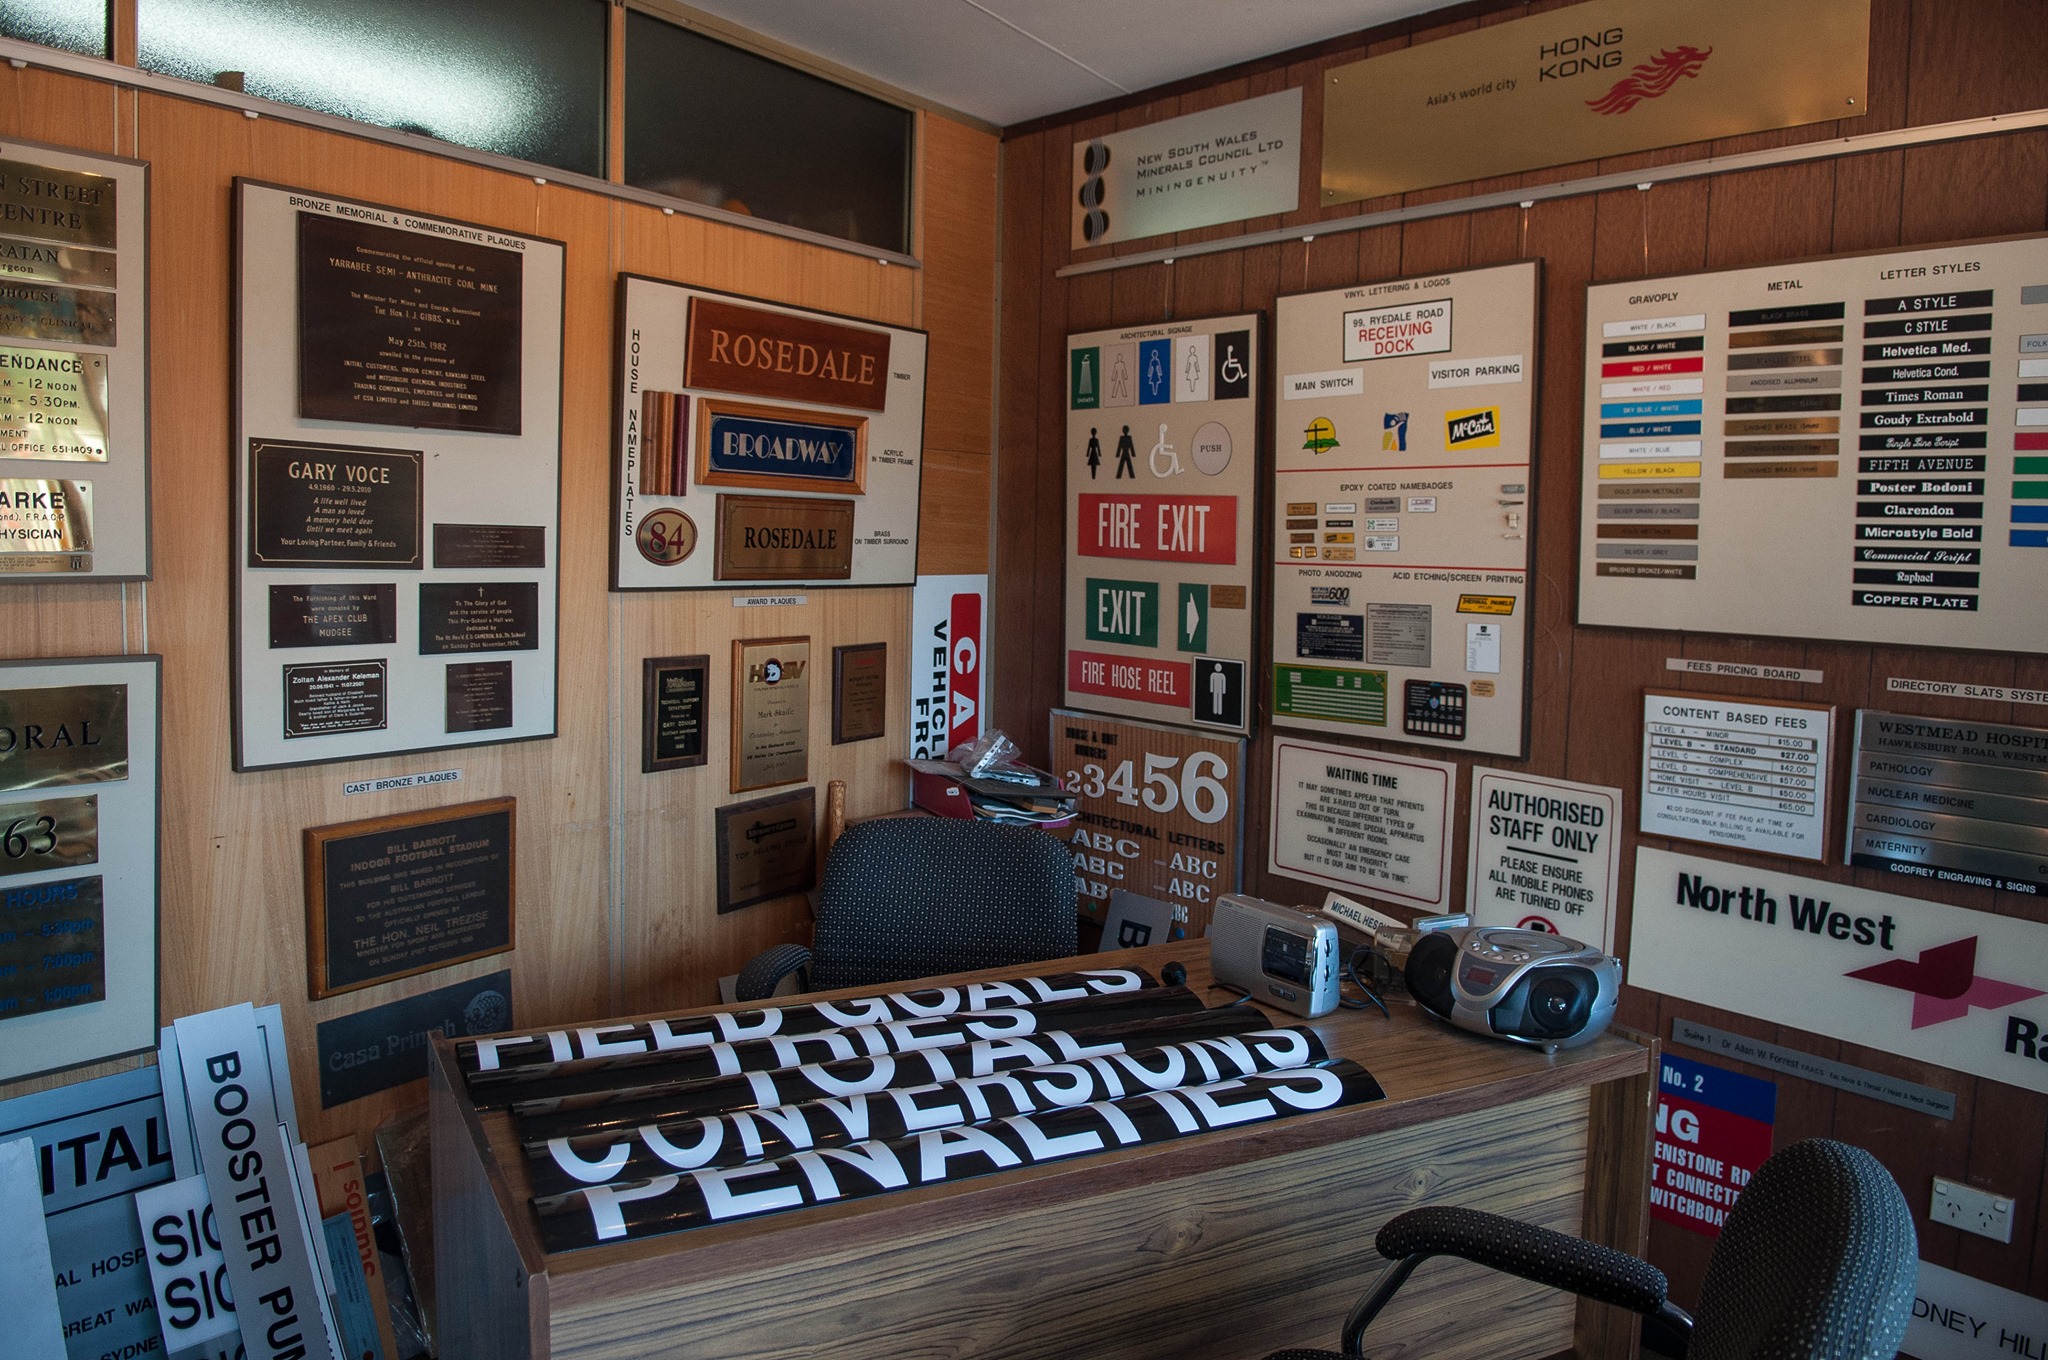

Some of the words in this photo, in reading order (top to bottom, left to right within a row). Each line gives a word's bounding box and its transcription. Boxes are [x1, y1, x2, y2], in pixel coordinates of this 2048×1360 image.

[1541, 27, 1623, 60] HONG
[1540, 50, 1622, 82] KONG
[1426, 90, 1456, 106] Asia's
[1460, 84, 1493, 99] world
[1497, 78, 1517, 92] city
[1138, 154, 1162, 165] NEW
[1168, 143, 1209, 158] SOUTH
[1215, 132, 1257, 148] WALES
[1137, 161, 1192, 179] MINERALS
[1199, 148, 1252, 166] COUNCIL
[290, 196, 331, 212] BRONZE
[336, 204, 387, 223] MEMORIAL
[393, 216, 399, 224] &
[405, 219, 482, 242] COMMEMORATIVE
[487, 234, 526, 250] PLAQUES
[330, 258, 371, 272] YARRABEE
[1880, 267, 1926, 280] LETTER
[1933, 262, 1980, 275] STYLES
[1369, 283, 1410, 296] LETTERING
[1424, 278, 1450, 288] LOGOS
[1768, 280, 1802, 291] METAL
[1629, 292, 1678, 305] GRAVOPLY
[1898, 300, 1907, 311] A
[1914, 296, 1956, 310] STYLE
[1370, 312, 1411, 325] RYEDALE
[1417, 308, 1443, 318] ROAD
[1905, 323, 1912, 333] C
[1916, 320, 1948, 332] STYLE
[1120, 329, 1164, 339] ARCHITECTURAL
[1168, 326, 1192, 334] SIGNAGE
[1359, 322, 1432, 342] RECEIVING
[709, 329, 875, 385] ROSEDALE
[1375, 338, 1414, 355] DOCK
[1882, 344, 1936, 357] Helvetica
[1942, 342, 1971, 354] Med.
[631, 329, 640, 393] HOUSE
[1432, 368, 1470, 379] VISITOR
[1475, 364, 1520, 376] PARKING
[894, 372, 910, 381] TIMBER
[1893, 368, 1932, 379] Helvetica
[1936, 367, 1959, 377] Cond.
[1295, 382, 1316, 391] MAIN
[1321, 378, 1353, 389] SWITCH
[1886, 391, 1918, 402] Times
[1924, 390, 1963, 401] Roman
[1452, 413, 1495, 440] McCain
[1875, 414, 1912, 426] Goudy
[1916, 412, 1974, 424] Extrabold
[723, 432, 843, 464] BROADWAY
[1200, 444, 1222, 452] PUSH
[288, 462, 336, 481] GARY
[346, 465, 390, 484] VOCE
[625, 409, 638, 536] NAMEPLATES
[1870, 459, 1909, 470] FIFTH
[1918, 459, 1973, 469] AVENUE
[1340, 483, 1363, 491] EPOXY
[1400, 482, 1453, 490] NAMEBADGES
[1870, 482, 1915, 493] Poster
[1922, 482, 1972, 493] Bodoni
[1884, 505, 1954, 515] Clarendon
[650, 521, 684, 555] 84
[744, 527, 837, 550] ROSEDALE
[1098, 503, 1141, 548] FIRE
[1158, 504, 1209, 553] EXIT
[1865, 528, 1938, 538] Microstyle
[1942, 528, 1973, 538] Bold
[1863, 549, 1930, 561] Commercial
[1934, 551, 1971, 563] Script
[1486, 575, 1523, 584] PRINTING
[1897, 572, 1933, 583] Raphael
[770, 597, 796, 605] PLAQUES
[1329, 587, 1349, 599] 600
[1863, 594, 1918, 605] COPPER
[1922, 596, 1968, 608] PLATE
[1098, 589, 1146, 636] EXIT
[319, 628, 352, 637] MUDGEE
[1082, 661, 1105, 685] FIRE
[1112, 664, 1142, 691] HOSE
[1148, 668, 1176, 695] REEL
[1687, 662, 1711, 672] FEES
[1718, 664, 1757, 676] PRICING
[1764, 668, 1800, 679] BOARD
[1891, 680, 1956, 694] DIRECTORY
[1965, 686, 2003, 698] SLATS
[1664, 706, 1719, 721] CONTENT
[1727, 711, 1767, 726] BASED
[1776, 716, 1807, 729] FEES
[1880, 721, 1977, 742] WESTMEAD
[1781, 752, 1809, 761] $27.00
[1878, 738, 1958, 753] HAWKESBURY
[1963, 746, 1997, 759] ROAD,
[1326, 766, 1368, 784] WAITING
[1372, 774, 1397, 789] TIME
[1870, 762, 1933, 777] PATHOLOGY
[346, 784, 370, 794] CAST
[376, 778, 412, 790] BRONZE
[417, 771, 457, 784] PLAQUES
[1489, 789, 1604, 827] AUTHORISED
[1868, 788, 1918, 802] NUCLEAR
[1923, 794, 1974, 810] MEDICINE
[1866, 814, 1936, 831] CARDIOLOGY
[4, 815, 57, 859] 63
[1072, 828, 1140, 858] ABC
[1169, 831, 1224, 855] LETTERS
[1490, 815, 1543, 842] STAFF
[1553, 827, 1598, 853] ONLY
[1866, 839, 1926, 856] MATERNITY
[1169, 852, 1216, 879] ABC
[1501, 857, 1537, 875] PLEASE
[1542, 865, 1582, 883] ENSURE
[1489, 869, 1507, 883] ALL
[1512, 873, 1547, 892] MOBILE
[1552, 883, 1593, 902] PHONES
[1890, 864, 1934, 879] GODFREY
[1938, 871, 1992, 888] ENGRAVING
[1996, 880, 2002, 888] &
[2006, 881, 2036, 893] SIGNS
[1168, 878, 1210, 903] ABC
[1331, 901, 1361, 923] MICHAEL
[1496, 887, 1515, 900] ARE
[1521, 891, 1560, 910] TURNED
[1565, 902, 1584, 916] OFF
[1677, 873, 1776, 926] North
[1790, 894, 1895, 951] West
[1663, 1066, 1687, 1089] No.
[1694, 1076, 1704, 1092] 2
[548, 1024, 1310, 1182] CONVERSIONS
[206, 1050, 282, 1272] BOOSTER
[587, 1066, 1344, 1239] PENALTIES
